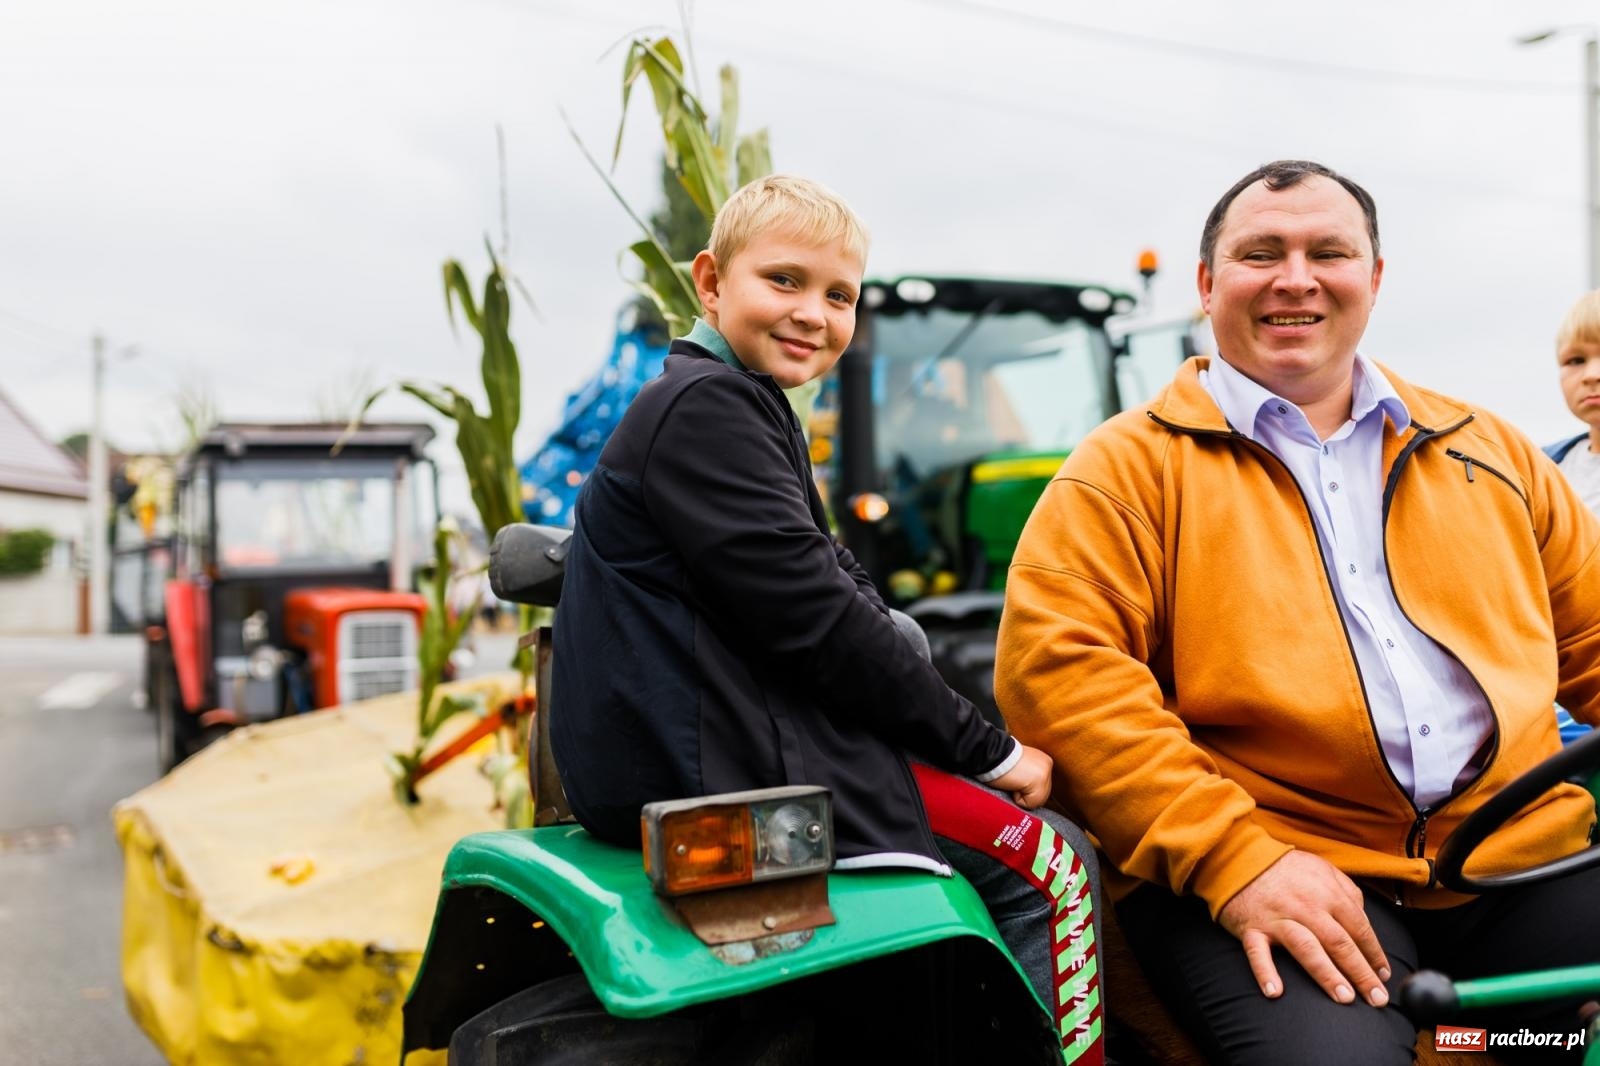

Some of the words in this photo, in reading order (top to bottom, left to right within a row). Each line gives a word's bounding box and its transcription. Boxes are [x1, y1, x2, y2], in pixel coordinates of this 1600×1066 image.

[1010, 834, 1022, 848] GOLD
[1039, 847, 1086, 971] ADVENTURE
[1071, 975, 1091, 1048] WAVE
